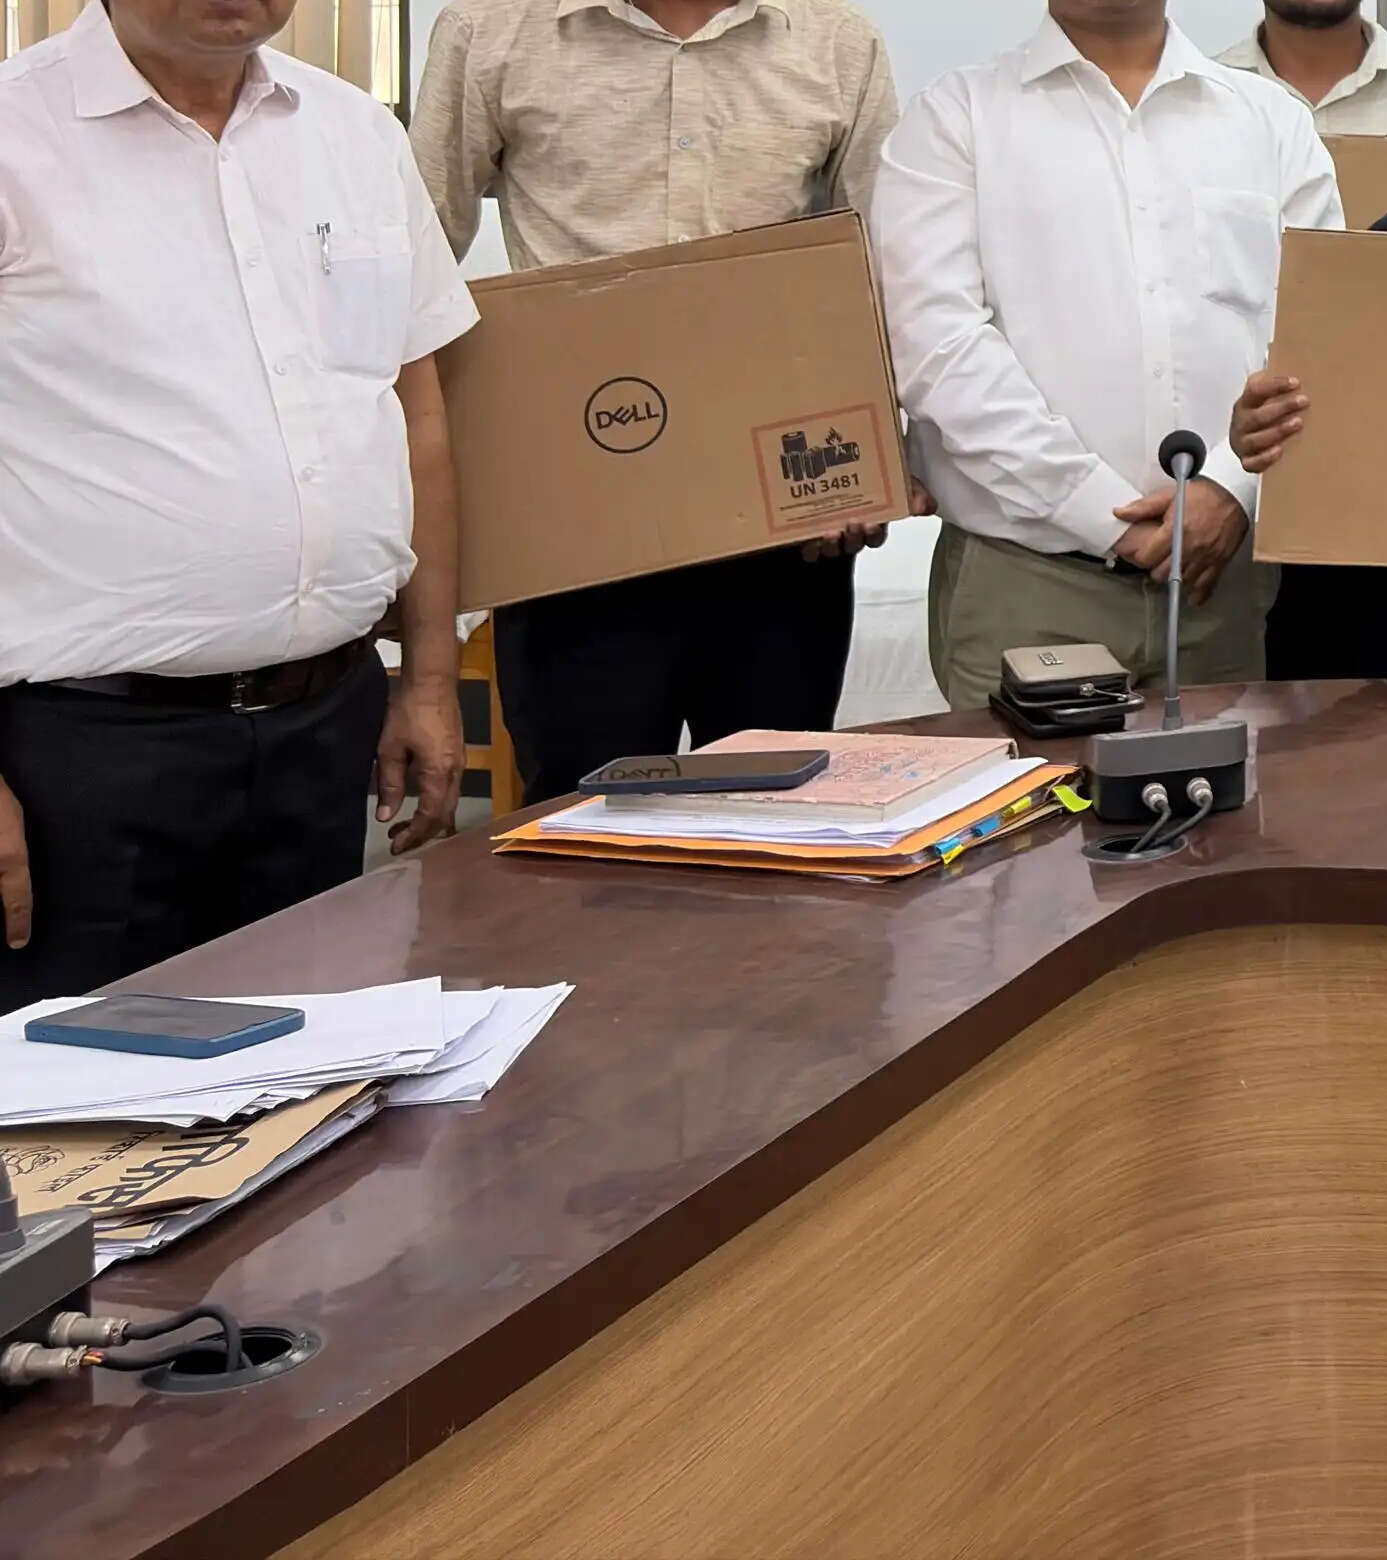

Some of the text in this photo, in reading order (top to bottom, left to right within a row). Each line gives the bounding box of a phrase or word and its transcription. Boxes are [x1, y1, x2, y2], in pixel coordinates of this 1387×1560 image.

[595, 401, 660, 430] DELL
[790, 473, 860, 499] UN 3481
